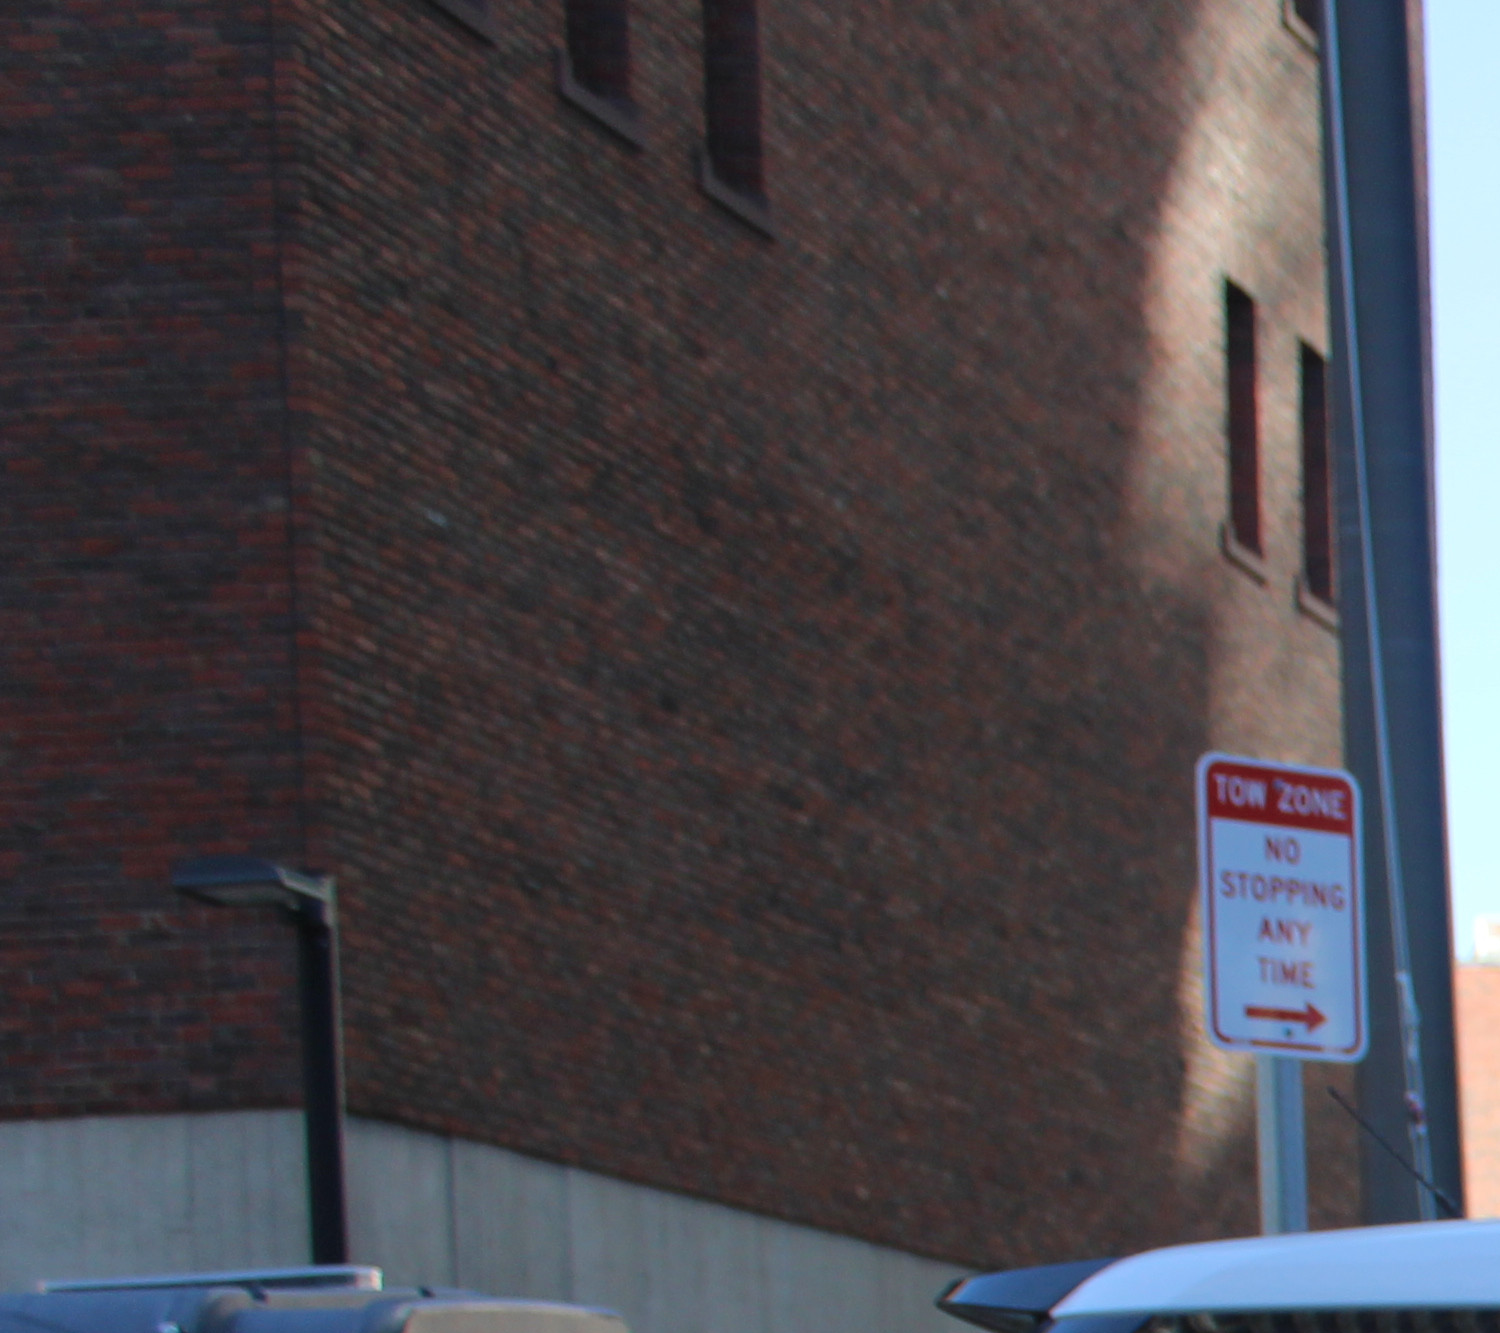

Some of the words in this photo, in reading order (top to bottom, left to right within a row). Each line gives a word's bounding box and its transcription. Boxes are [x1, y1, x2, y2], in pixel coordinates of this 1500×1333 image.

[1213, 774, 1267, 809] TOW
[1277, 783, 1347, 820] ZONE
[1264, 836, 1300, 866] NO
[1220, 871, 1346, 912] STOPPING
[1257, 919, 1313, 945] ANY
[1257, 957, 1315, 989] TIME
